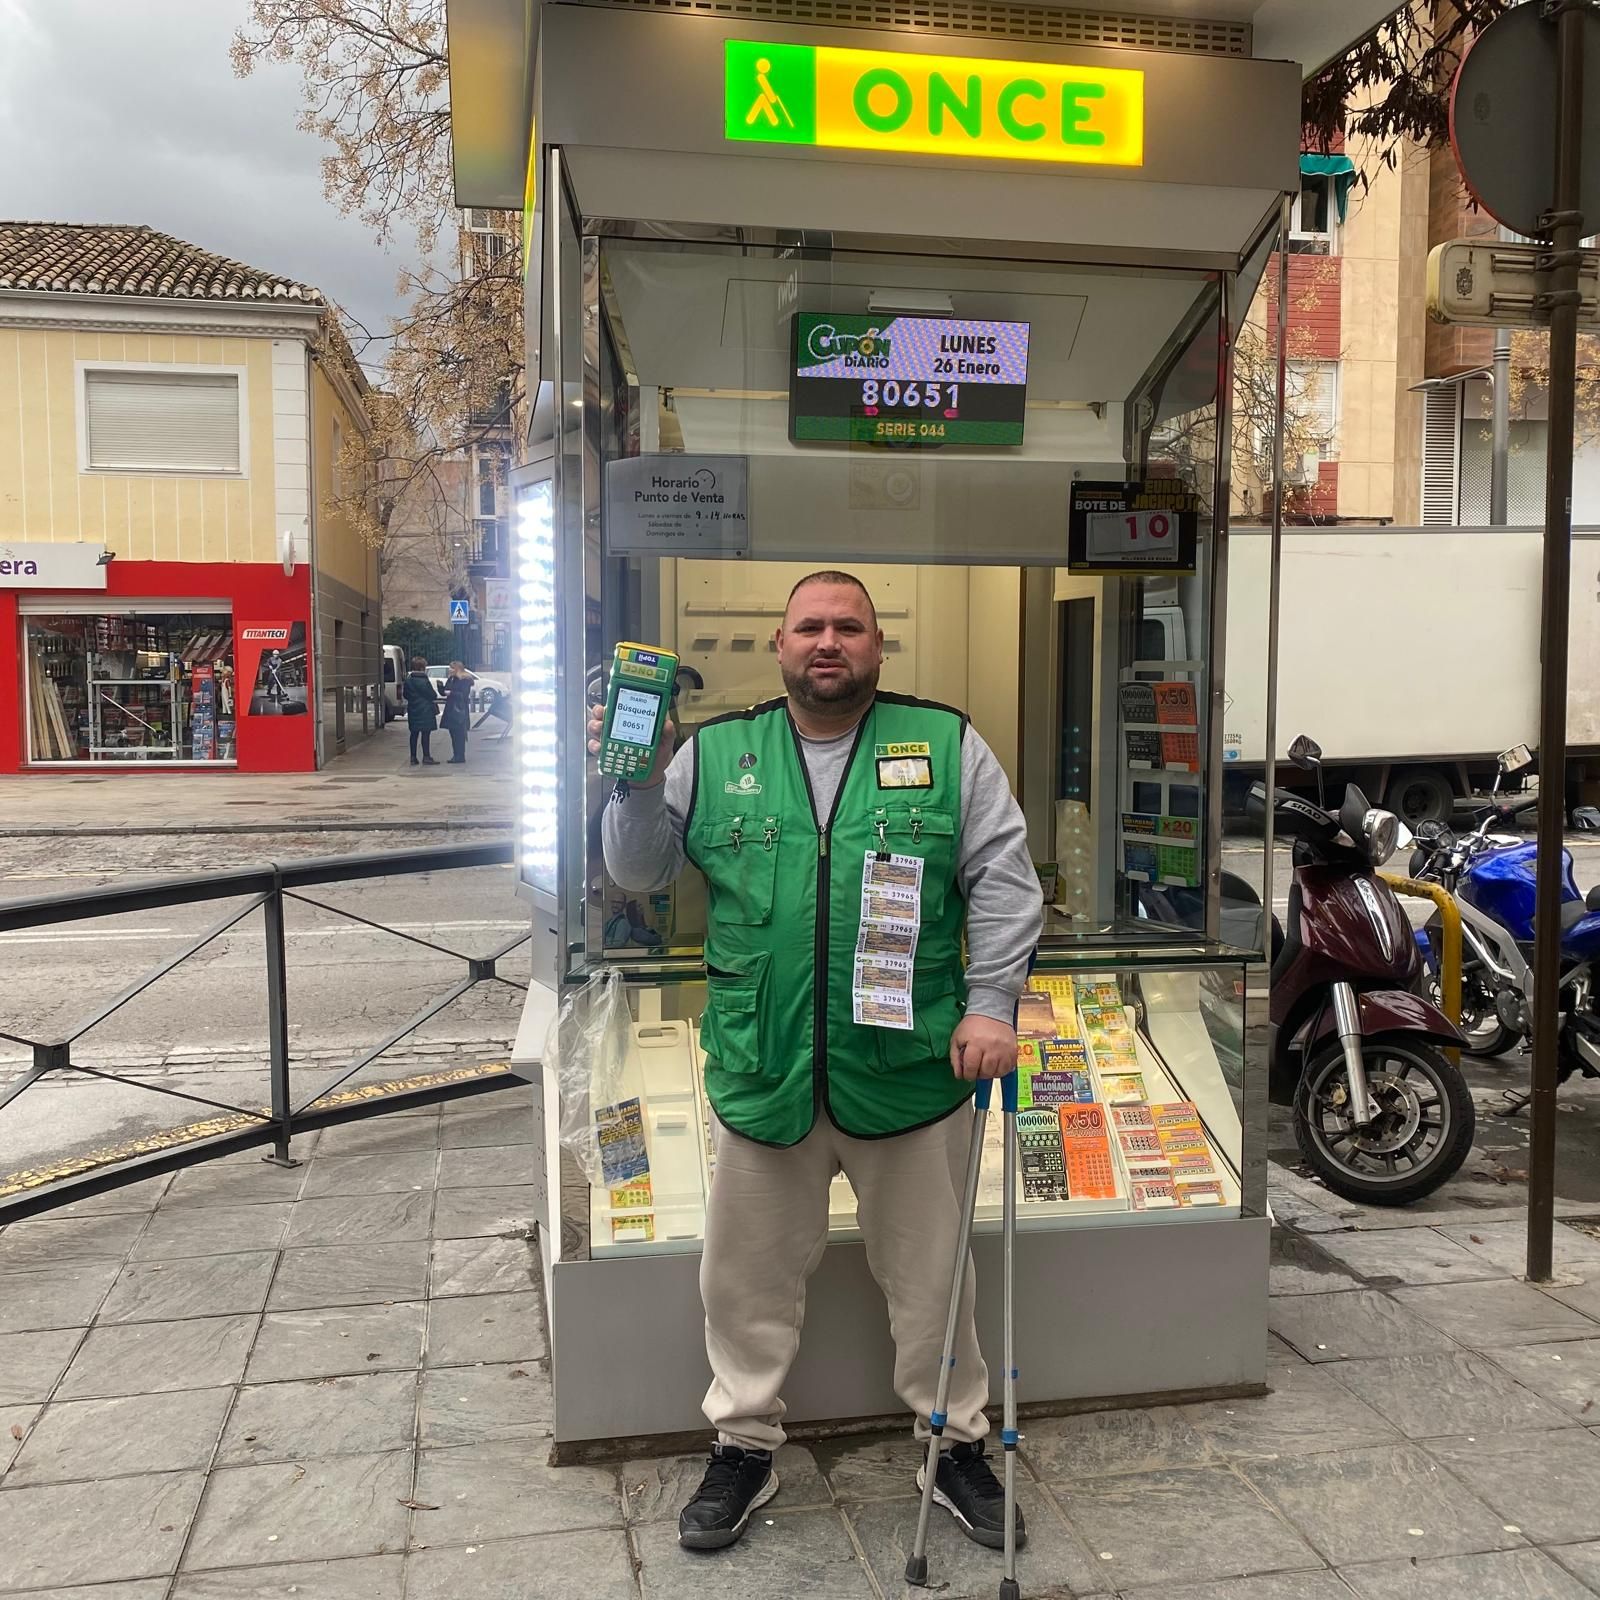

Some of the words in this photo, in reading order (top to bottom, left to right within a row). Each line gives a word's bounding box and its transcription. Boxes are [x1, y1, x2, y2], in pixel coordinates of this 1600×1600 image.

[852, 68, 1106, 146] ONCE
[940, 335, 997, 355] LUNES
[934, 358, 953, 374] 26
[958, 359, 1000, 375] Enero
[862, 379, 960, 409] 80651
[876, 423, 916, 436] SERIE
[920, 424, 945, 436] 044
[652, 476, 699, 488] Horario
[635, 491, 669, 502] Punto
[673, 491, 687, 502] de
[691, 492, 724, 503] Venta
[1075, 501, 1107, 510] BOTE
[1110, 501, 1126, 510] DE
[1125, 514, 1169, 540] 10
[0, 560, 37, 575] era
[246, 630, 286, 638] TITANTECH
[617, 703, 656, 718] Búsqueda
[622, 720, 645, 731] 80651
[890, 744, 926, 754] ONCE
[1292, 802, 1321, 820] SHAD
[895, 856, 918, 866] 37965
[892, 891, 914, 900] 37965
[890, 924, 913, 934] 37965
[885, 959, 907, 969] 37965
[883, 995, 906, 1004] 37965
[1042, 1072, 1063, 1083] Mega
[1032, 1082, 1073, 1092] MILLONARIO
[1017, 1114, 1058, 1127] 1000000€
[1065, 1108, 1103, 1130] x50
